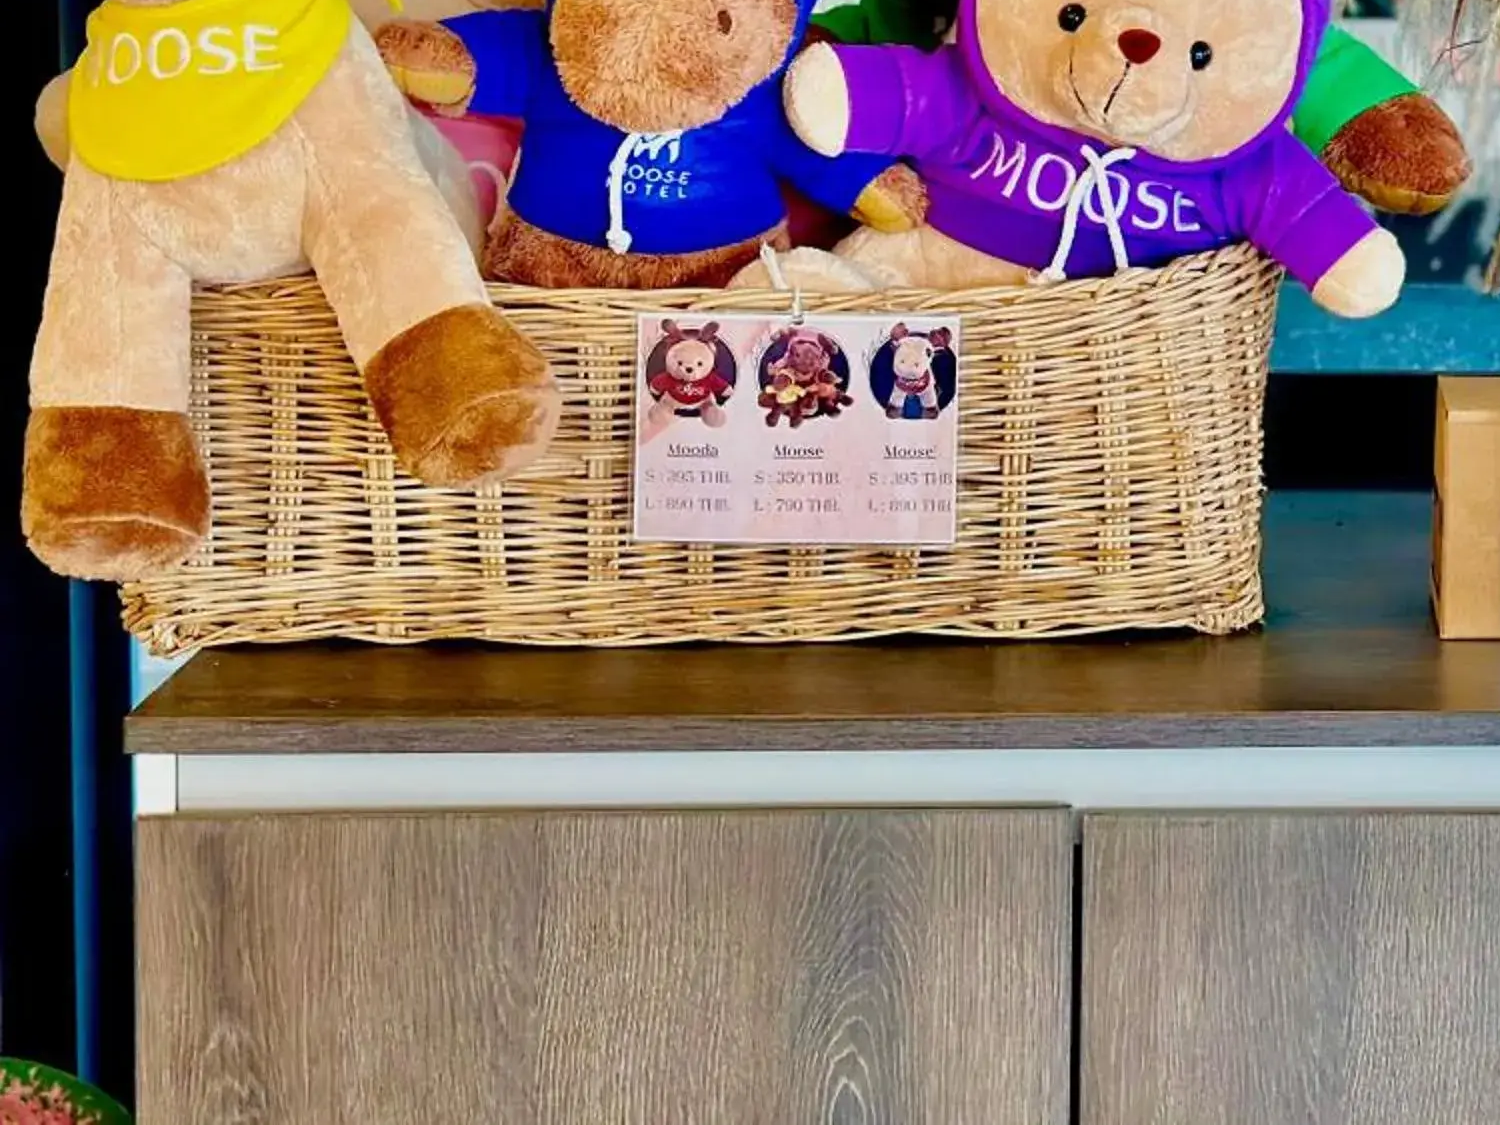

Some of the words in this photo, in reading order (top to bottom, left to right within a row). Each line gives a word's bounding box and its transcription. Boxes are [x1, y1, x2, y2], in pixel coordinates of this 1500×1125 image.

[612, 163, 692, 186] OOSE
[970, 132, 1201, 233] MOOSE
[773, 444, 824, 460] Moose
